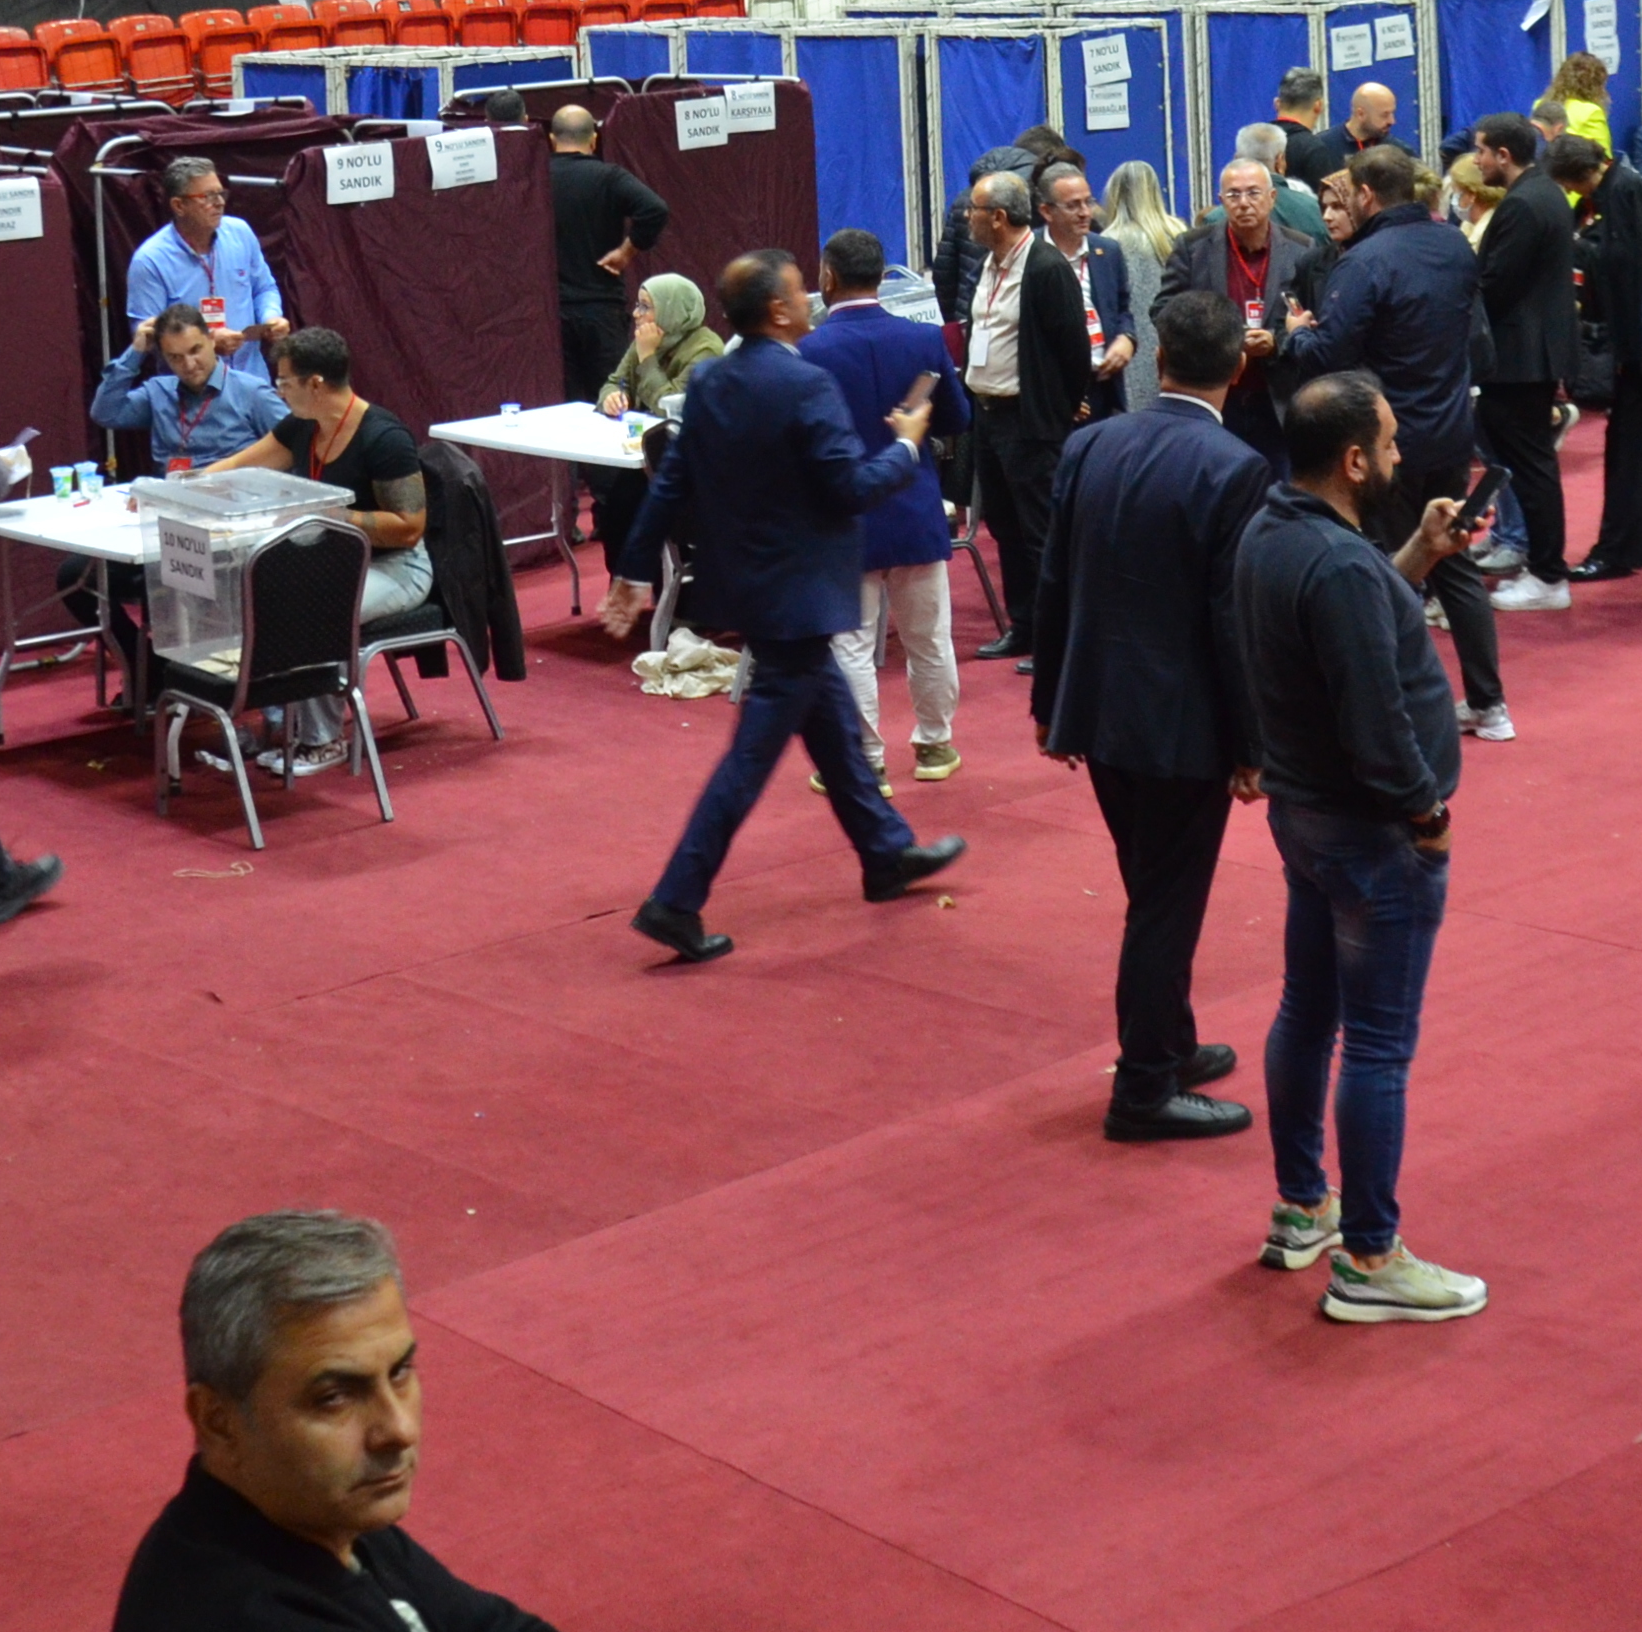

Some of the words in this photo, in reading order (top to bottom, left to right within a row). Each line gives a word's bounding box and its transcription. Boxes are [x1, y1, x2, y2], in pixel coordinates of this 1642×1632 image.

[687, 124, 720, 139] SANDIK
[435, 140, 443, 153] 9
[337, 158, 344, 170] 9
[347, 154, 382, 169] NO'LU
[339, 175, 383, 191] SANDIK
